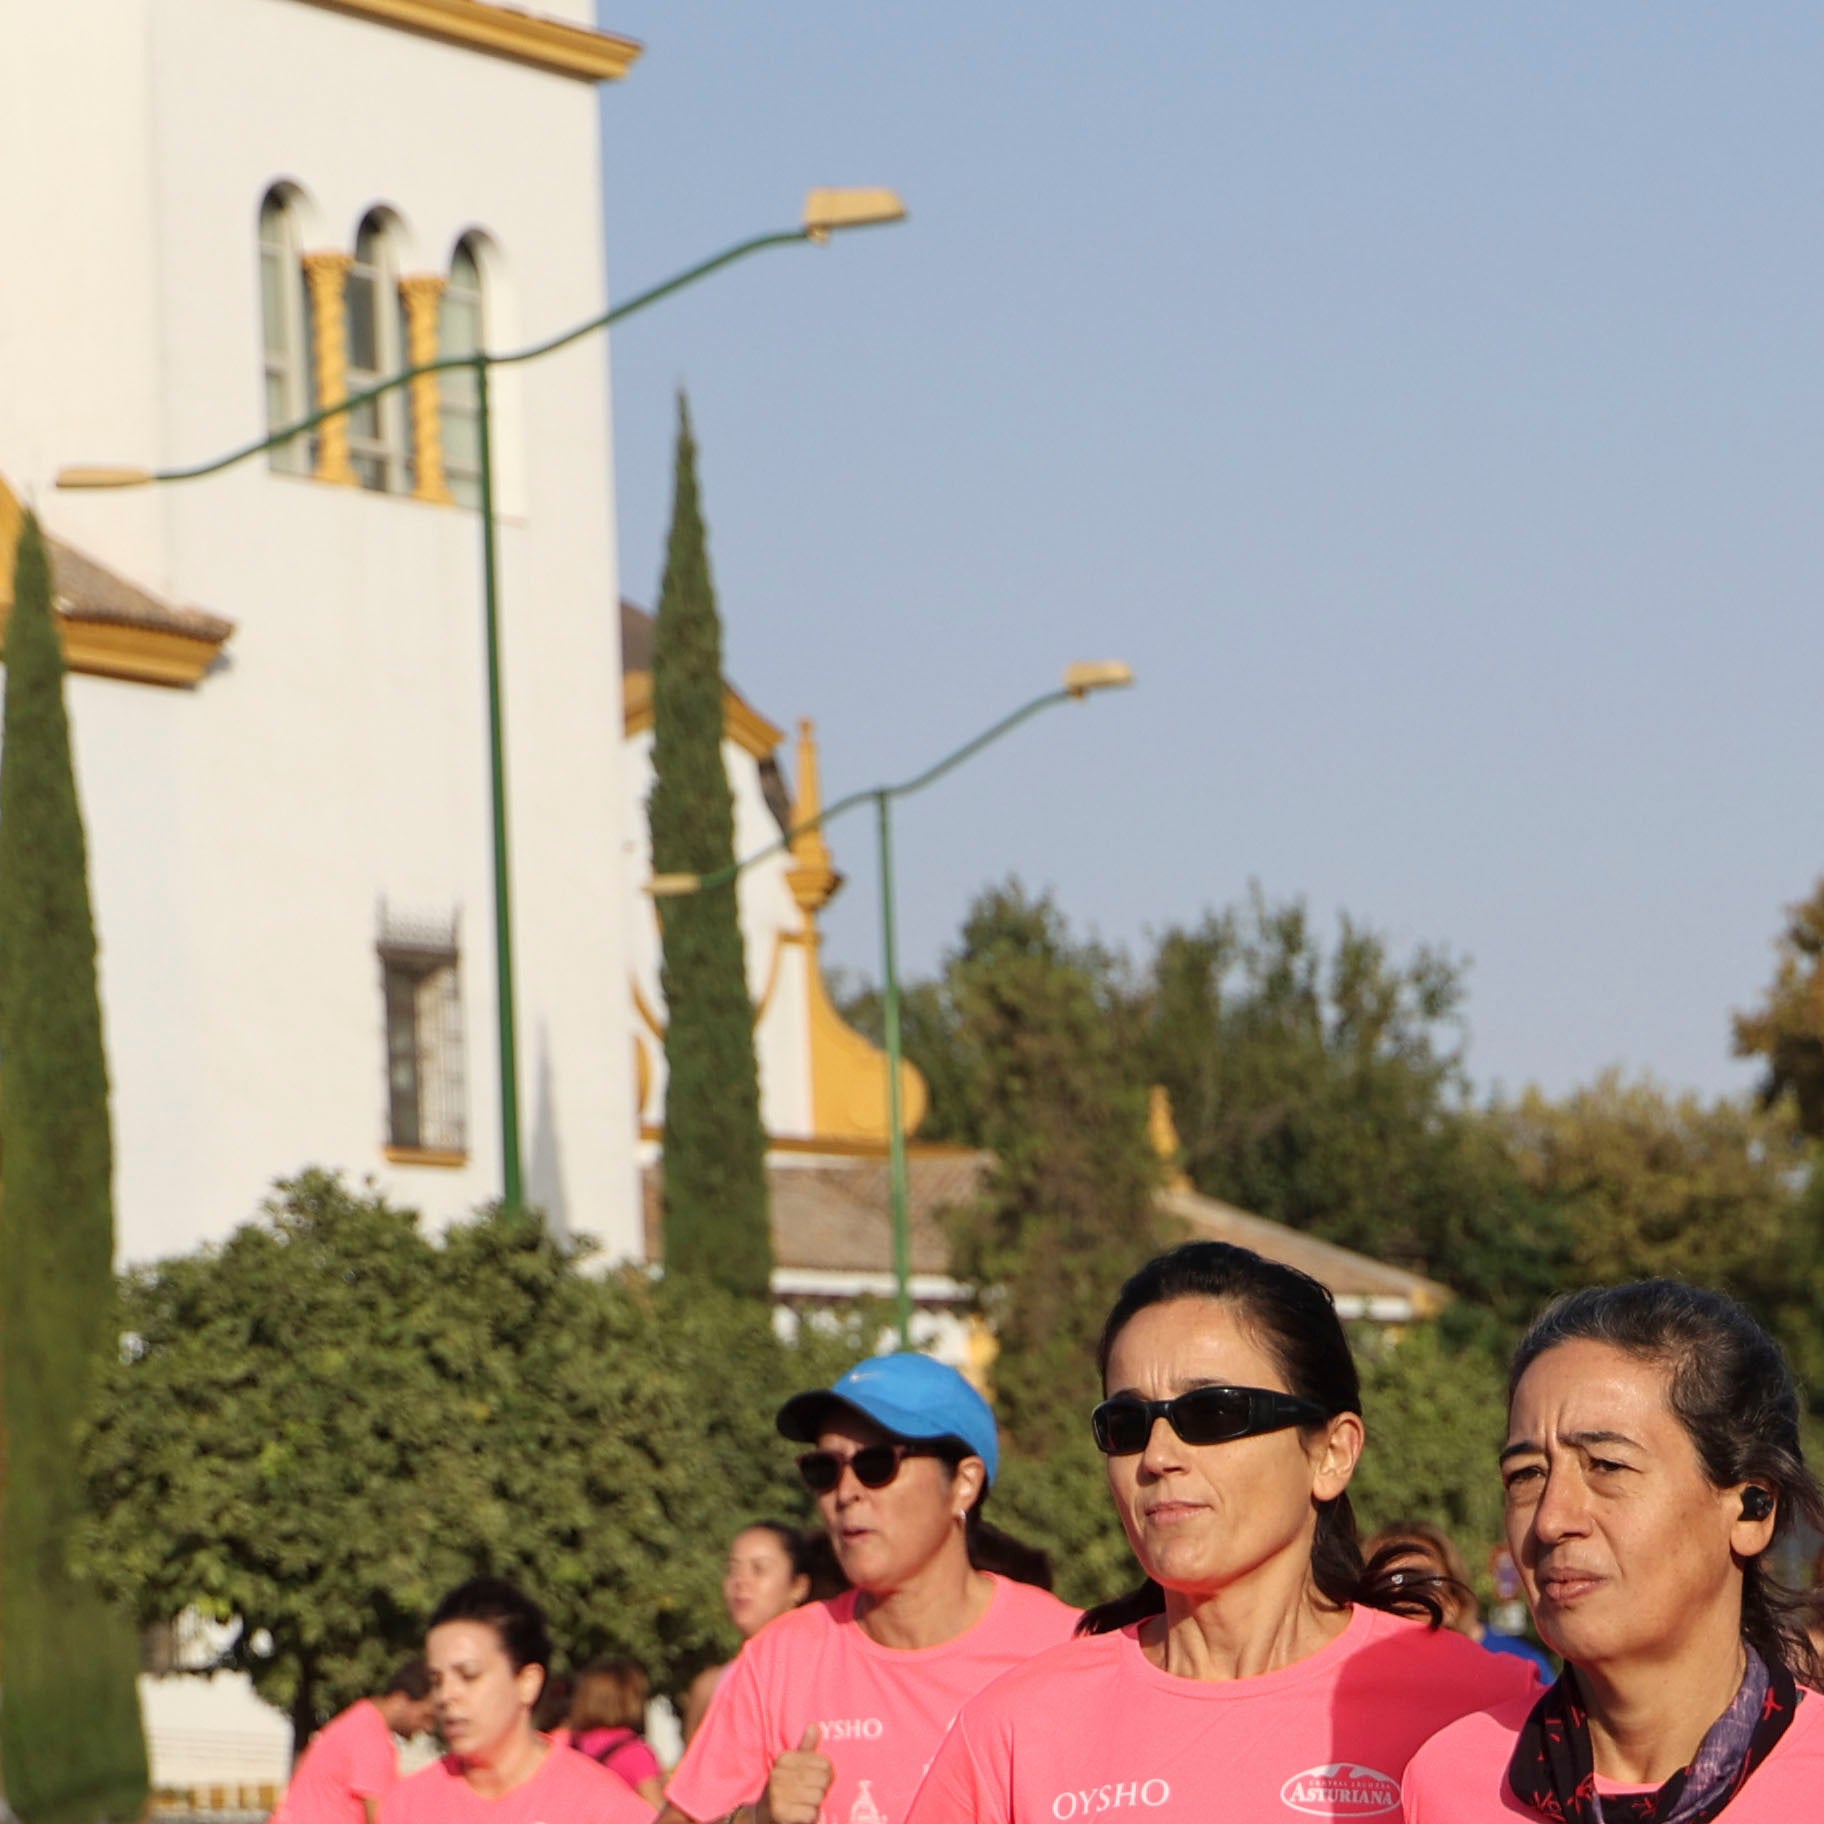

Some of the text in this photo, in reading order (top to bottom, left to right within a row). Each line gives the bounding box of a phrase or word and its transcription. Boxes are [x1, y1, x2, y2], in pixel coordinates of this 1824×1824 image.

[820, 1718, 883, 1741] YSHO
[1053, 1778, 1170, 1820] OYSHO
[1289, 1781, 1394, 1806] ASTURIANA
